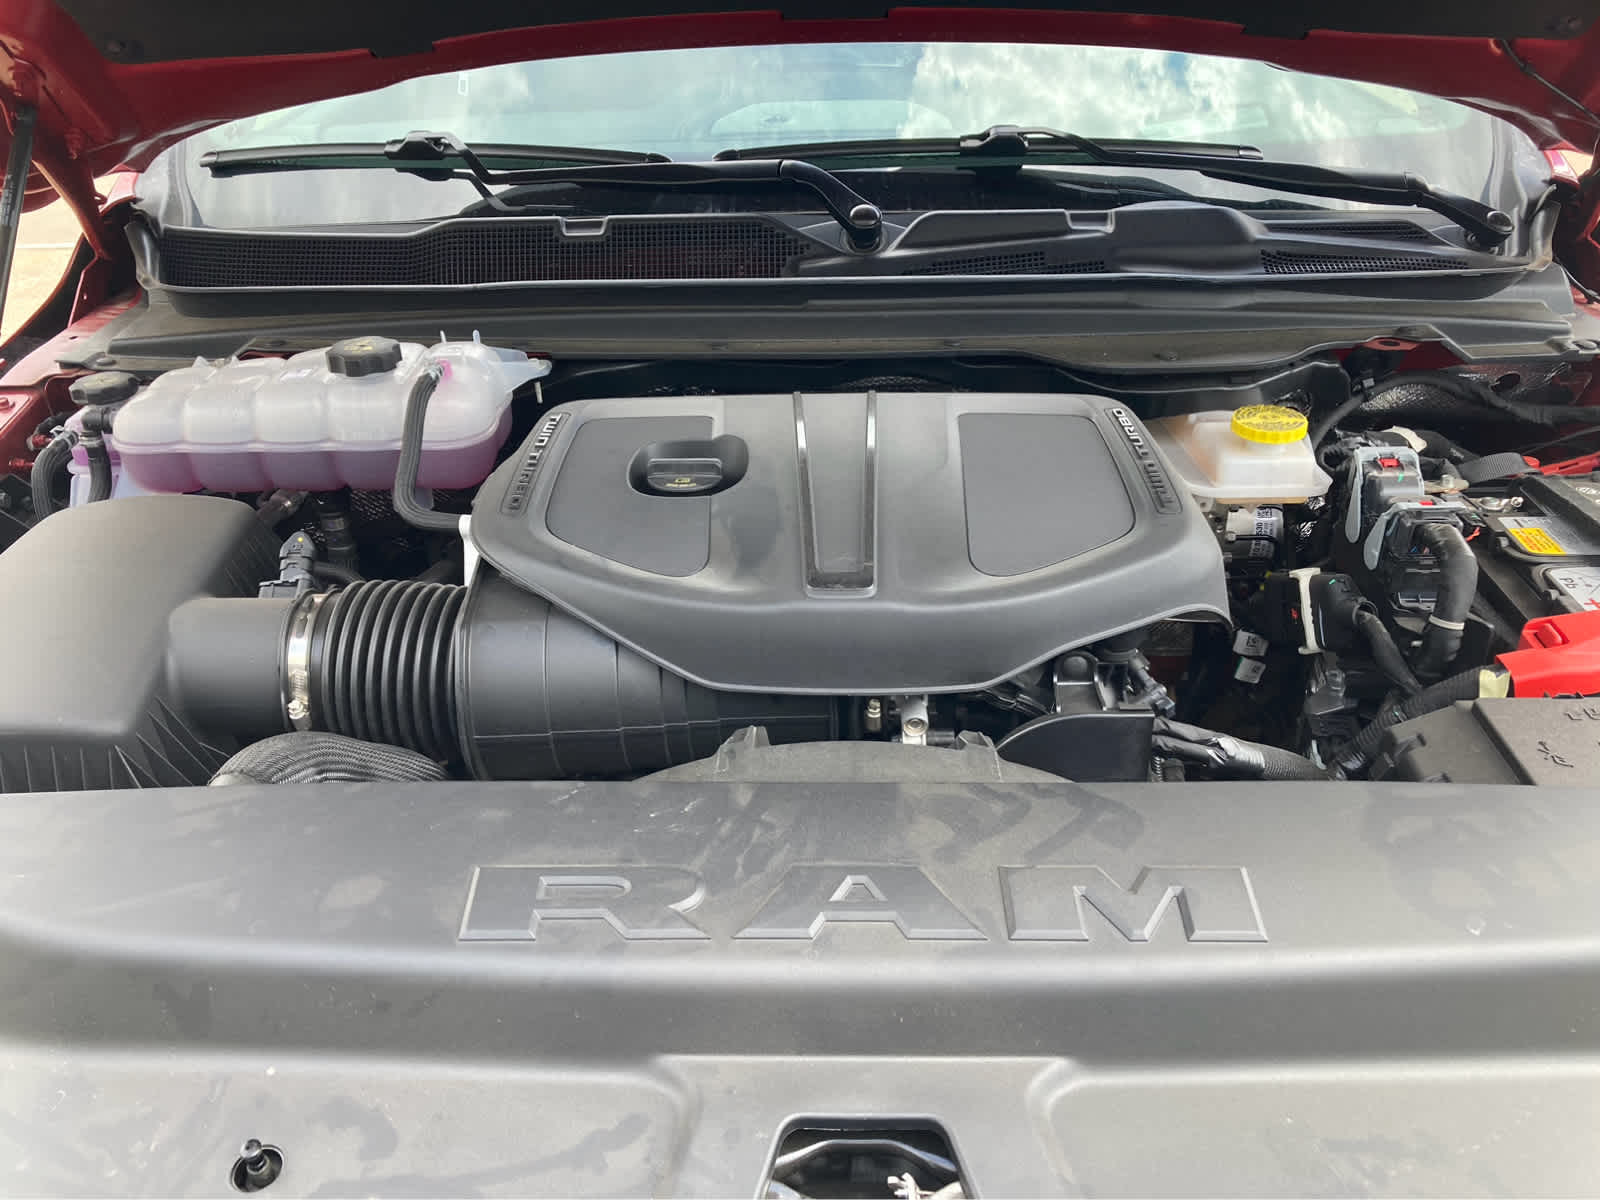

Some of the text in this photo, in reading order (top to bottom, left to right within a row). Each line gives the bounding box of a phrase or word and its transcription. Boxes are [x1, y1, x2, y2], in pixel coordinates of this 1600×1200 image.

[534, 413, 563, 448] TWIN
[1112, 407, 1150, 459] TURBO
[457, 864, 1270, 944] RAM
